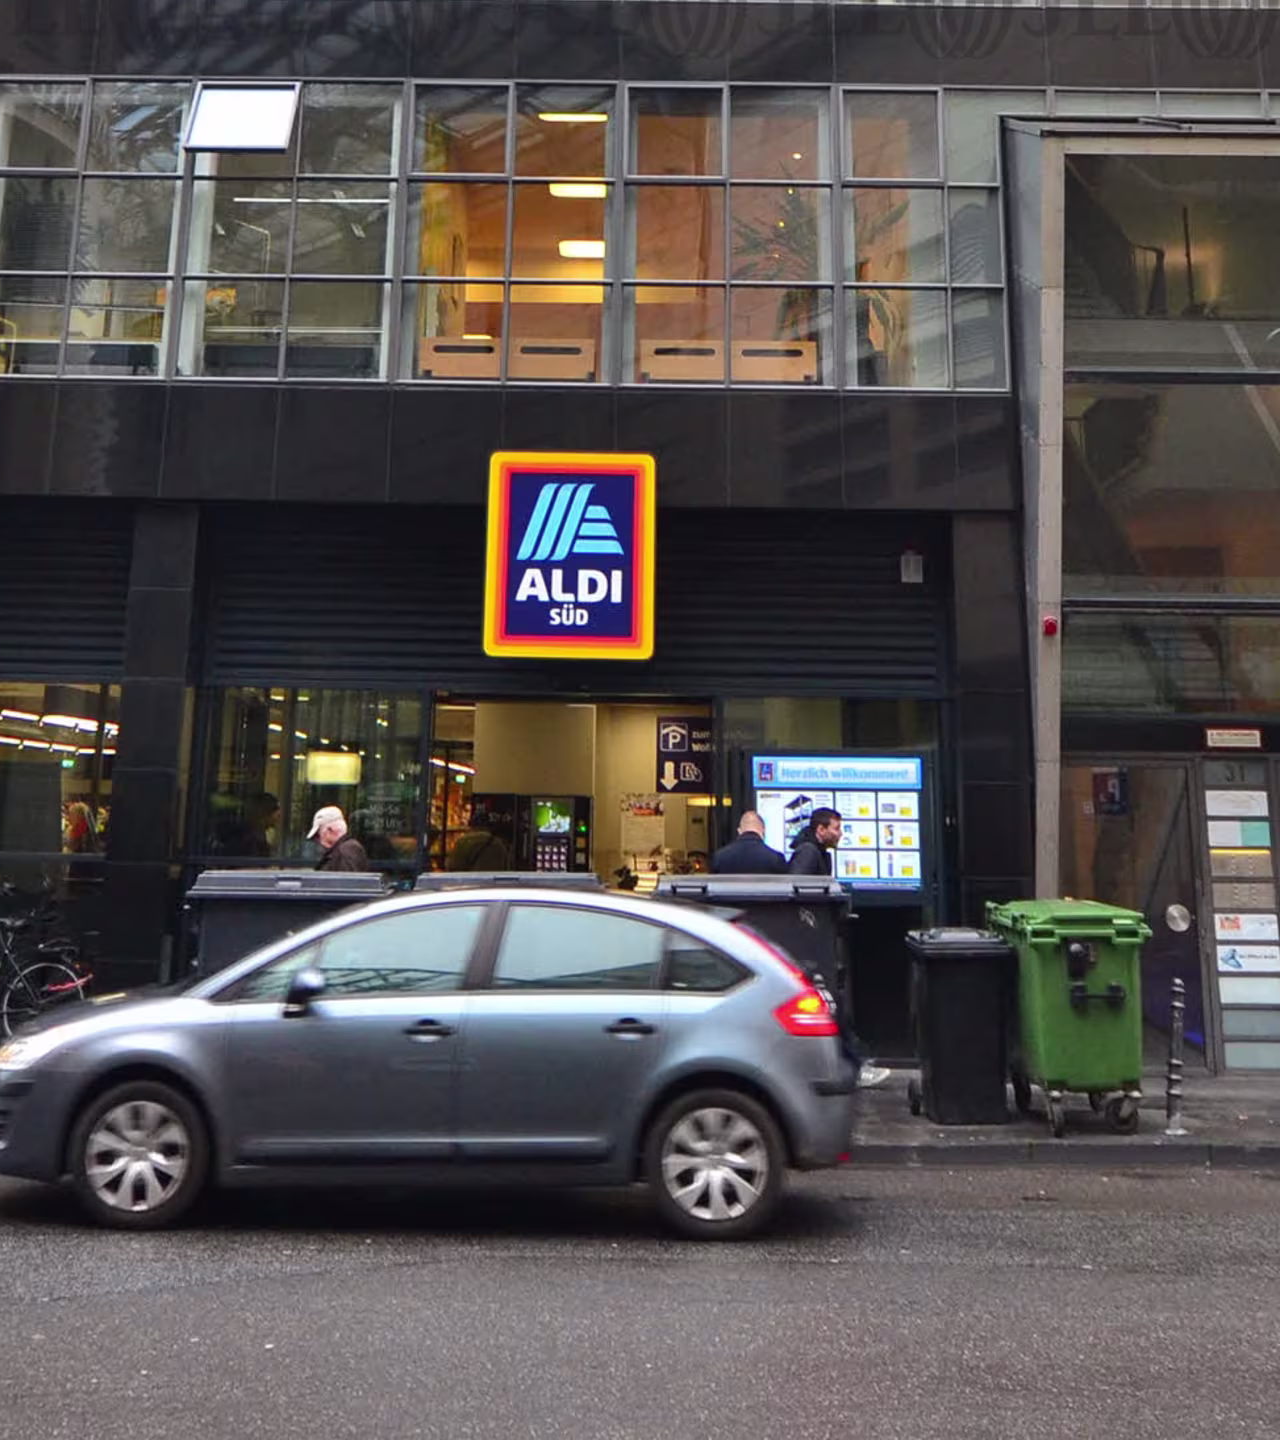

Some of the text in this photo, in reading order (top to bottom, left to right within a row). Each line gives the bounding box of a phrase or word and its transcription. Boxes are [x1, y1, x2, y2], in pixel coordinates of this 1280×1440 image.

[515, 568, 623, 603] ALDI
[549, 604, 589, 626] SÜD
[781, 767, 829, 779] Herzlich
[831, 767, 909, 779] willkommen!
